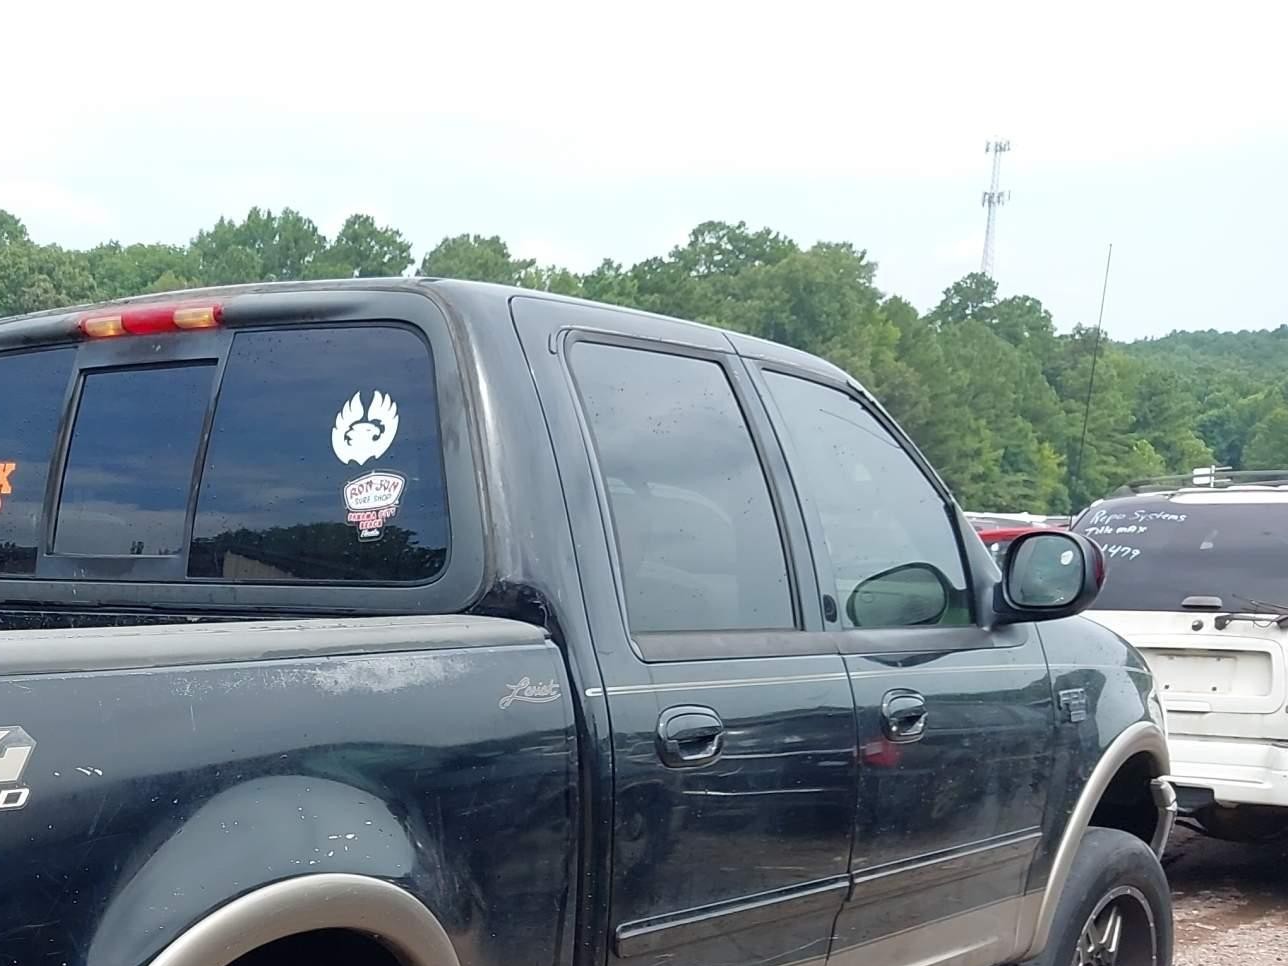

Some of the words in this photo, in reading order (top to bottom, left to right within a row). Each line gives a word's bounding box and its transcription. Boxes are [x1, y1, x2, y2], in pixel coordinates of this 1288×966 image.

[350, 479, 373, 499] RON
[376, 479, 399, 493] JON
[354, 495, 371, 505] SURF
[373, 493, 392, 502] SHOP
[1090, 509, 1127, 524] Repo
